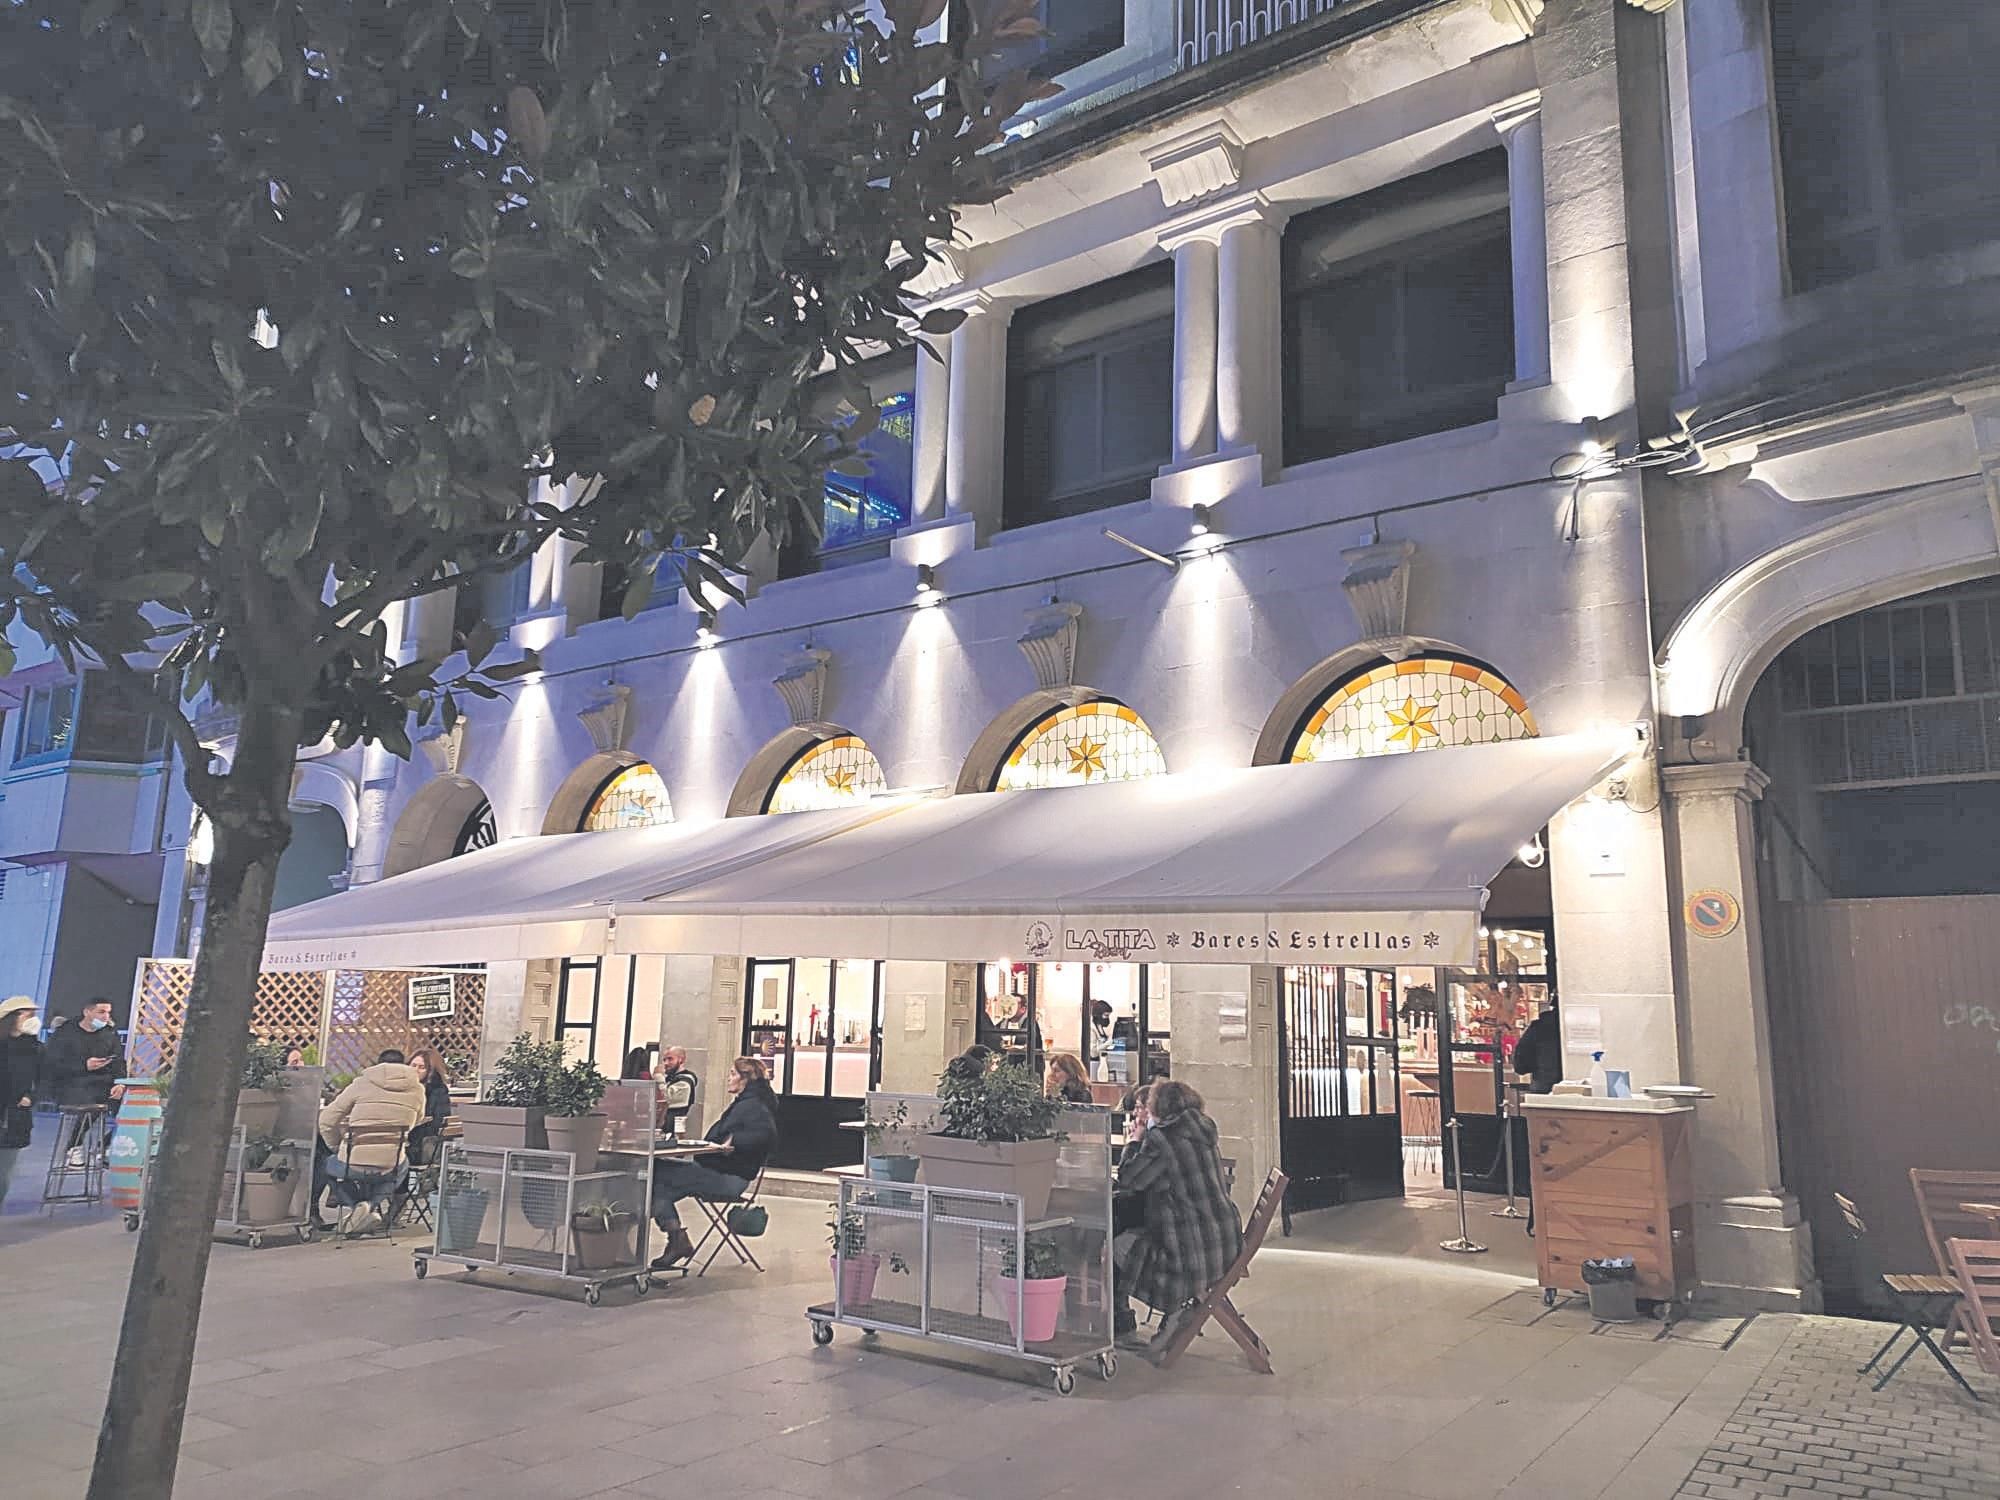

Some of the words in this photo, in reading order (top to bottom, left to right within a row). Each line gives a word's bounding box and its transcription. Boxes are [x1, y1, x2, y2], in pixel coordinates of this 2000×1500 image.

[1066, 929, 1100, 950] LA
[1103, 929, 1156, 950] TITA
[1190, 931, 1260, 950] Bares
[1266, 930, 1280, 949] &
[1288, 930, 1412, 950] Estrellas
